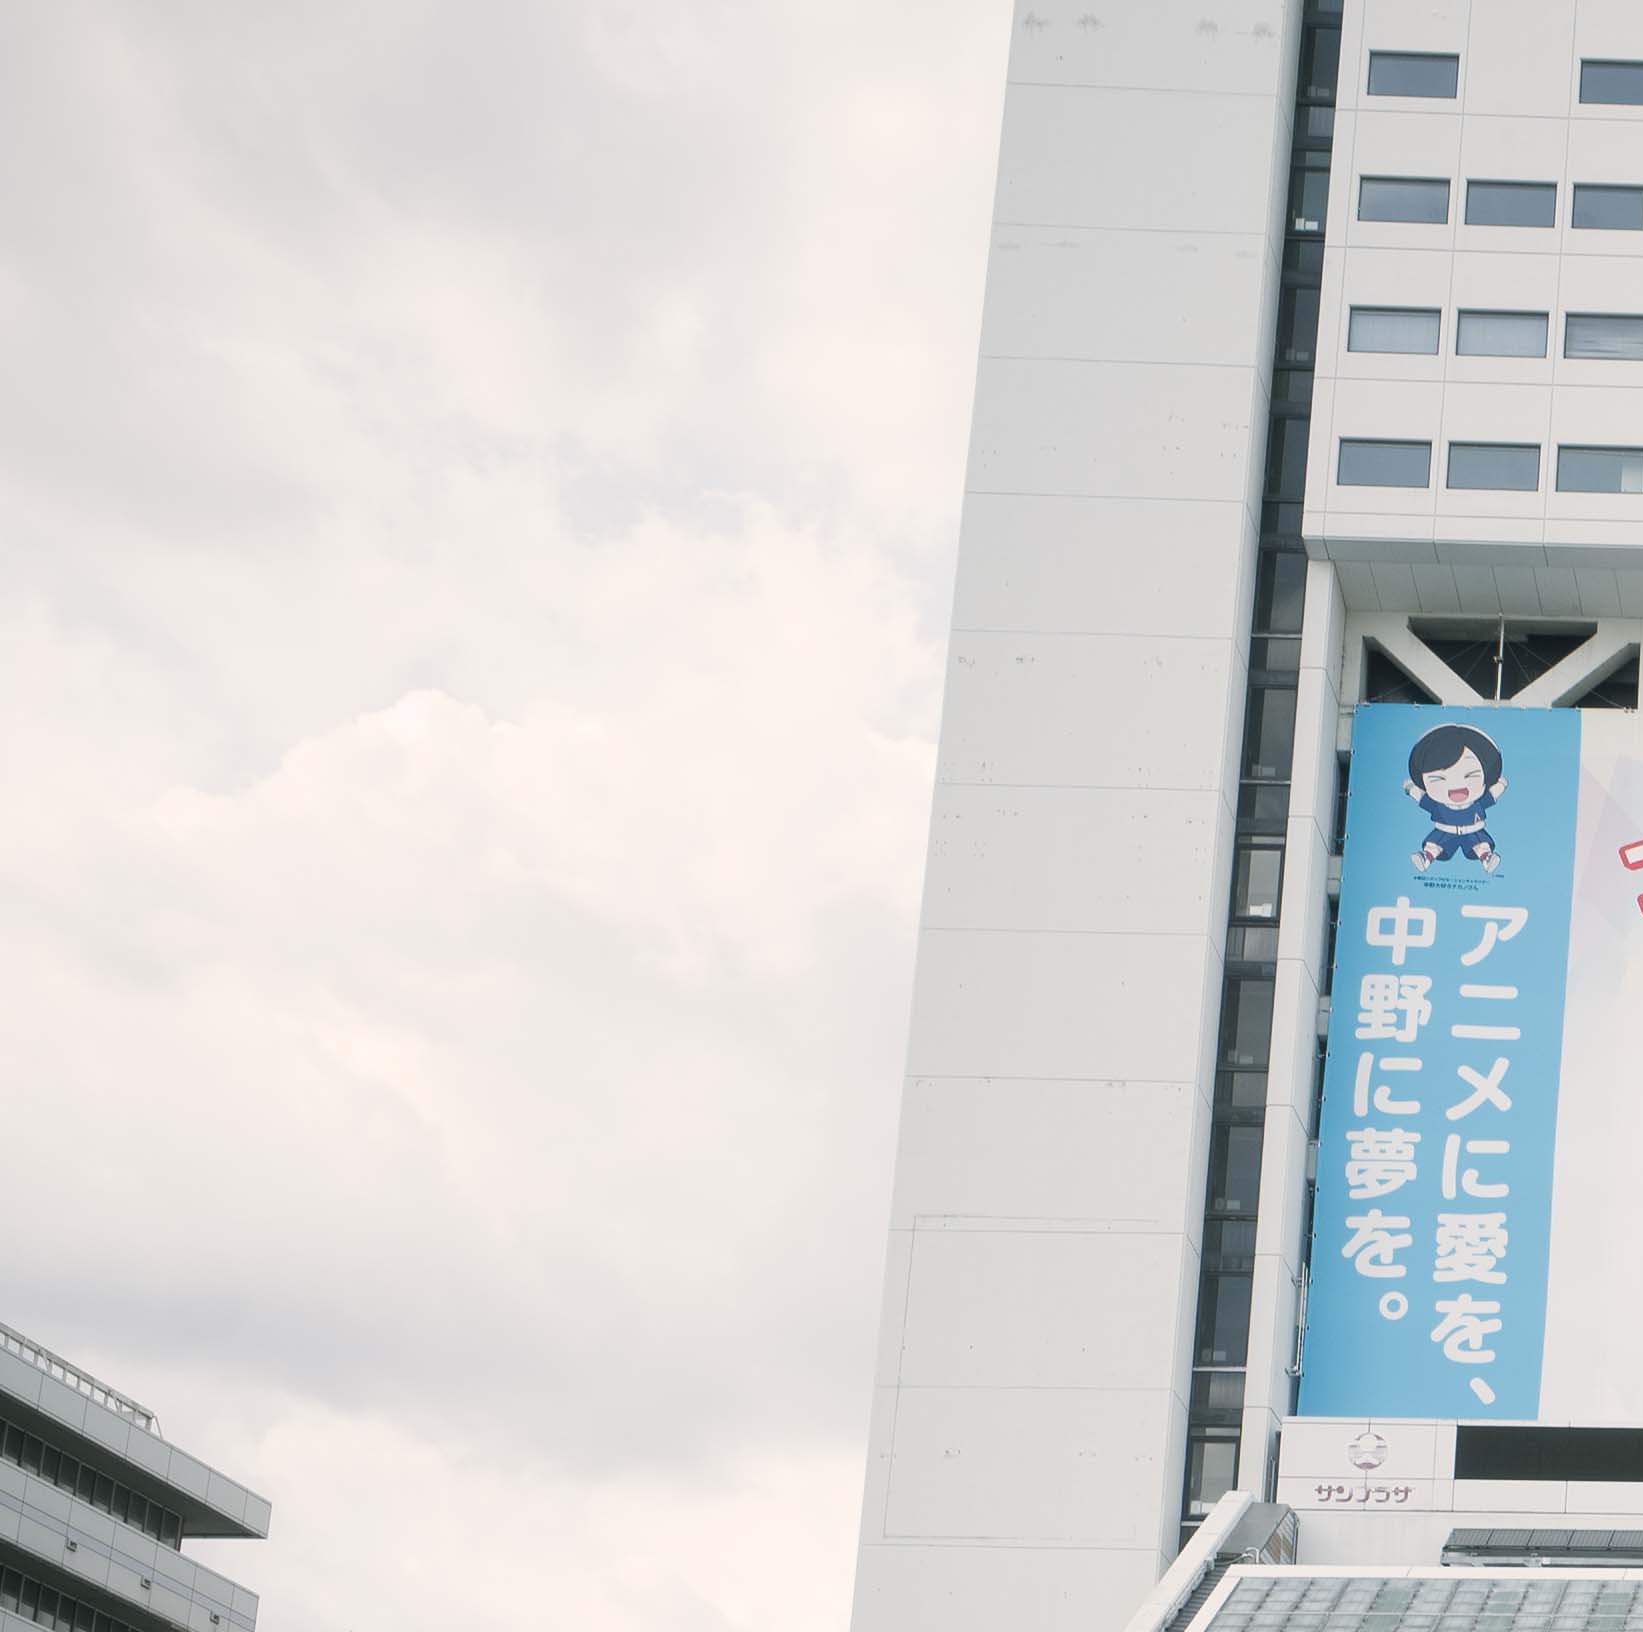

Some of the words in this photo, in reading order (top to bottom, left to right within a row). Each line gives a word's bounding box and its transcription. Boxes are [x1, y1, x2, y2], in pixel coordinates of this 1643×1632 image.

[1341, 895, 1437, 1322] 中野に夢を。
[1429, 899, 1532, 1405] アニメに愛を、
